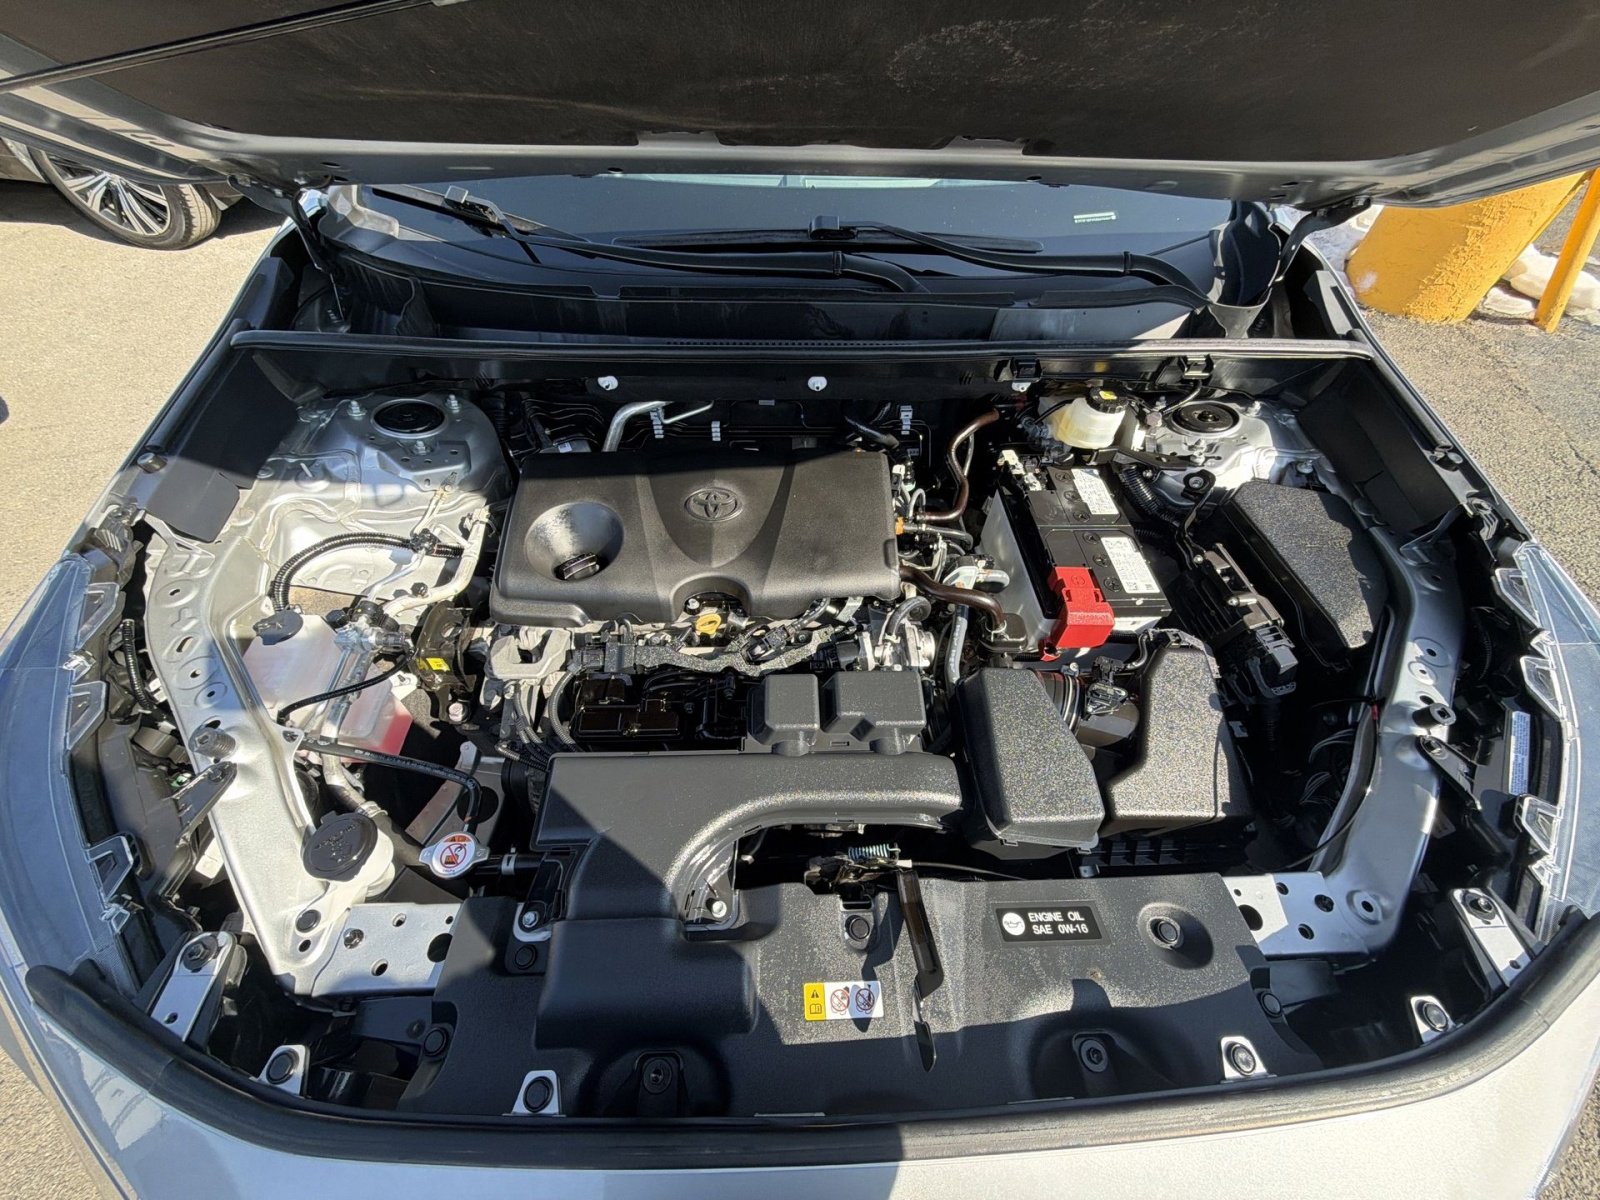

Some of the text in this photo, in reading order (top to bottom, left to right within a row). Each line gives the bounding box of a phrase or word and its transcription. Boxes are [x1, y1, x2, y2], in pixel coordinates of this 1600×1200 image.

[1027, 911, 1085, 922] ENGINE OIL
[1032, 923, 1089, 935] SAE 0W-16
